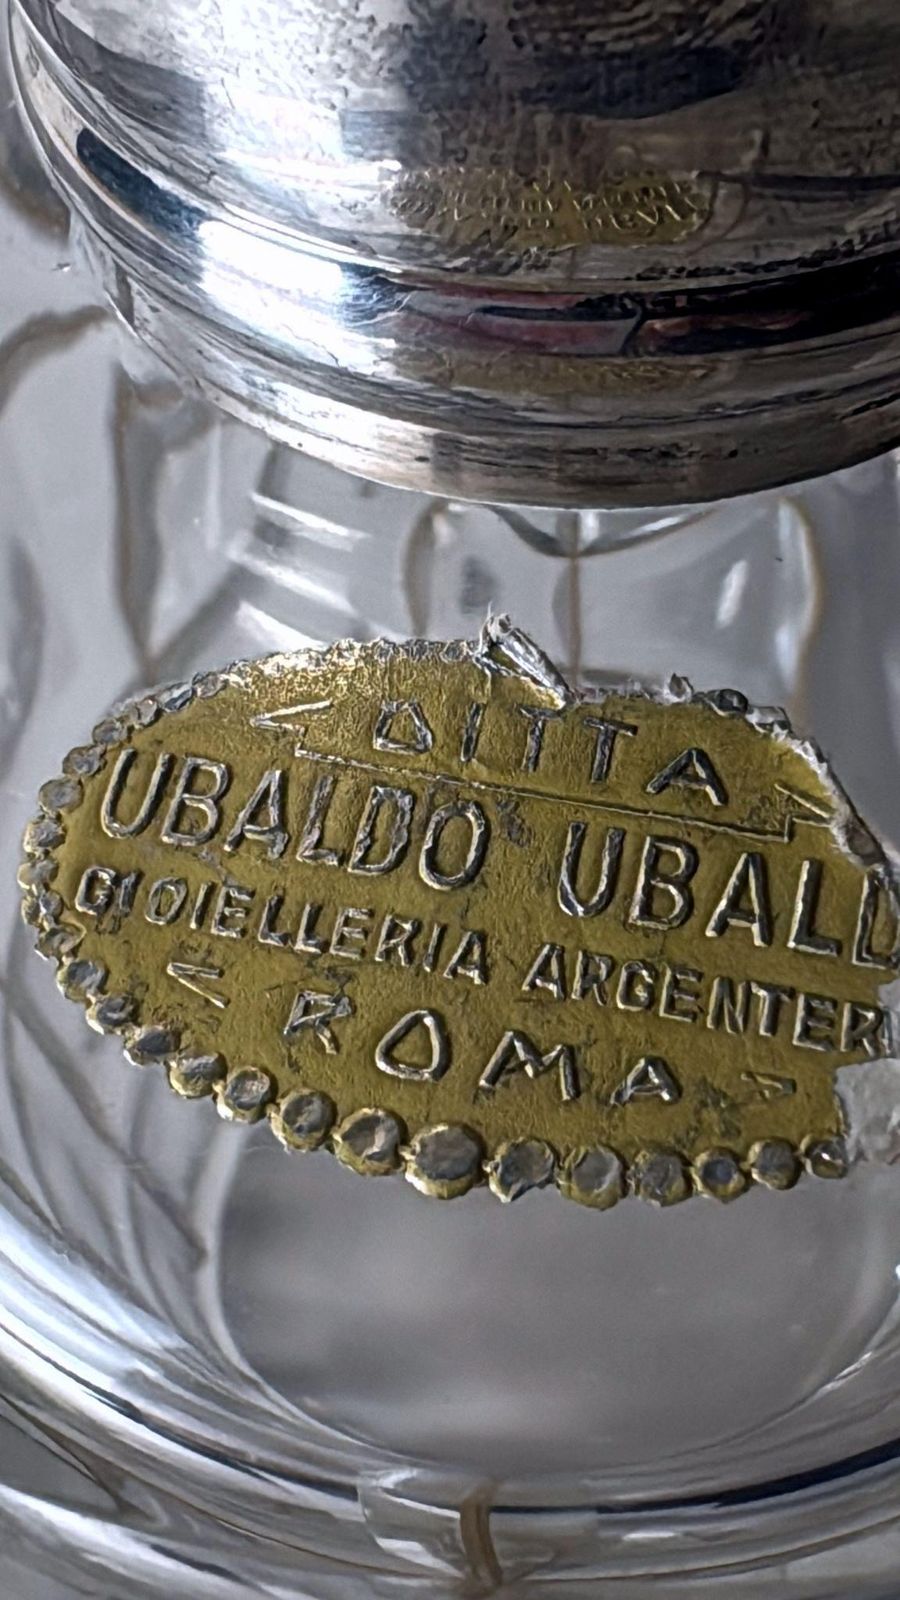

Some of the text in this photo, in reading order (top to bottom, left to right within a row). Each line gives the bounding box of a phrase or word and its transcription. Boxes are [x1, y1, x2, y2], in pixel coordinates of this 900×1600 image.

[373, 698, 723, 808] DITTA
[101, 748, 489, 891] UBALDO
[74, 866, 487, 986] GIOIELLERIA
[284, 989, 684, 1106] ROMA
